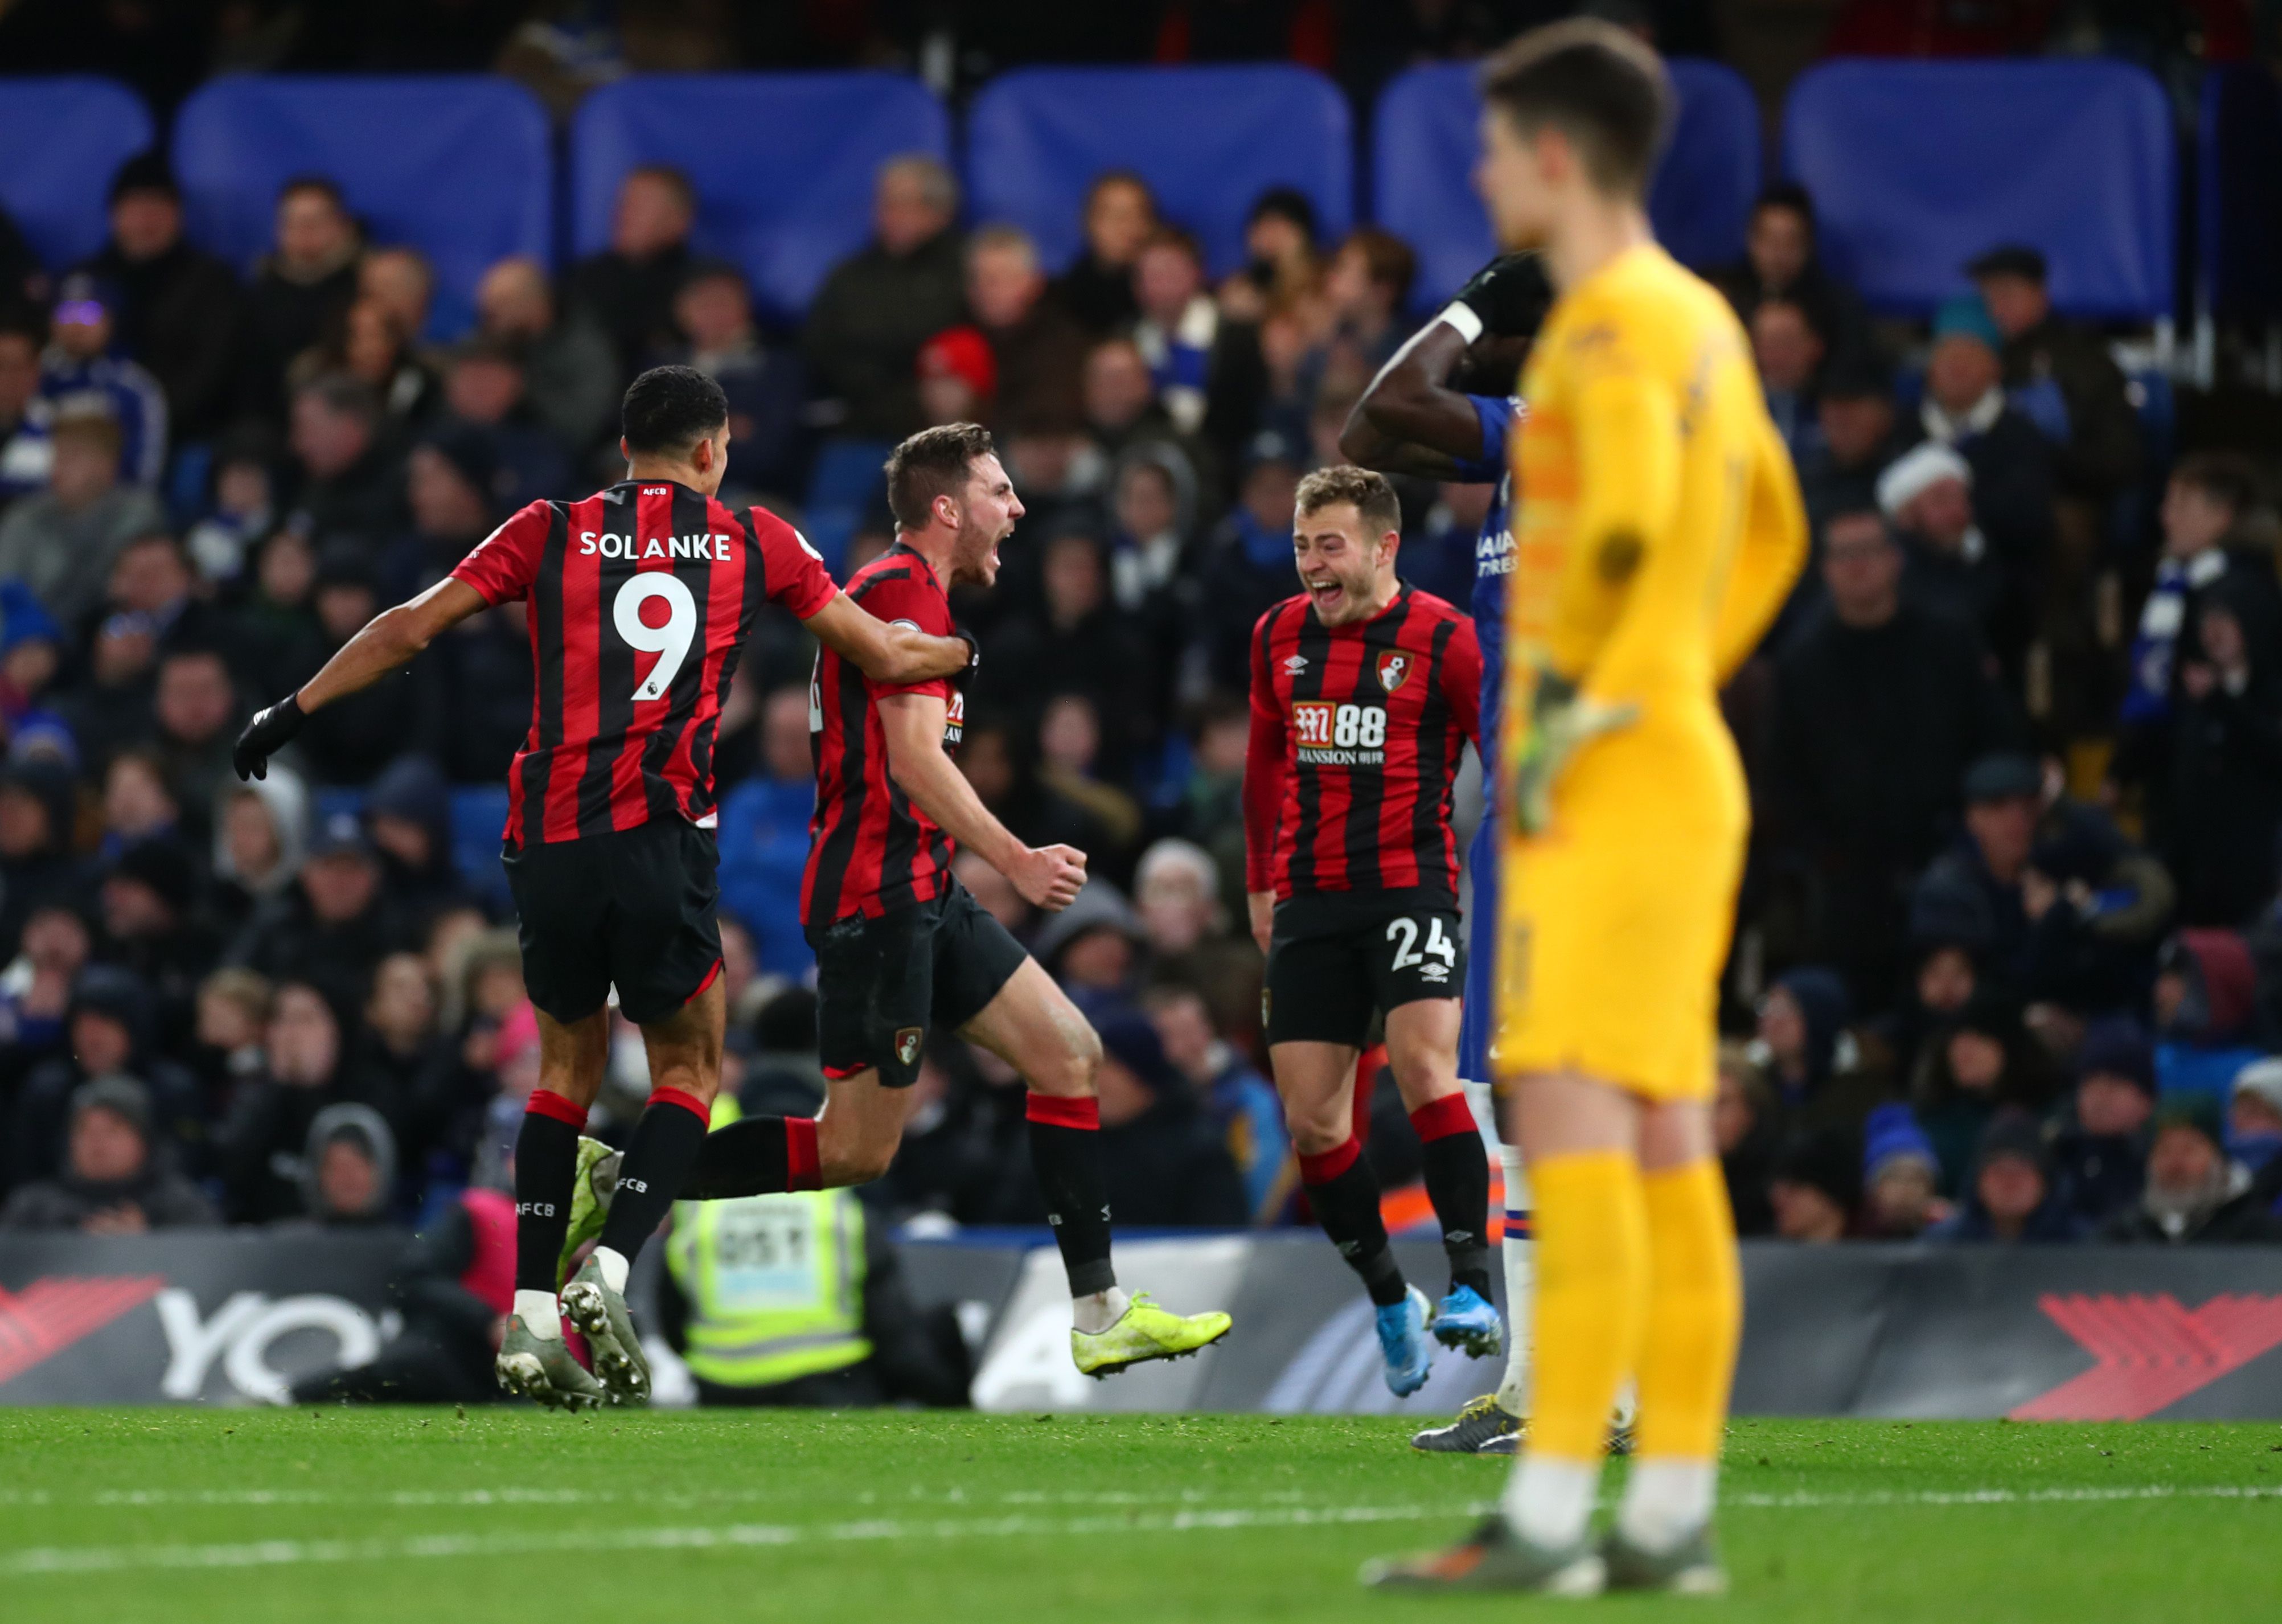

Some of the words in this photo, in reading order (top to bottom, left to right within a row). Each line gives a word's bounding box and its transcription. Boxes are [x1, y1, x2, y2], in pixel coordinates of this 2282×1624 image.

[643, 487, 667, 496] AFCB
[579, 531, 732, 561] SOLANKE
[613, 571, 697, 700] 9
[1386, 916, 1456, 972] 24
